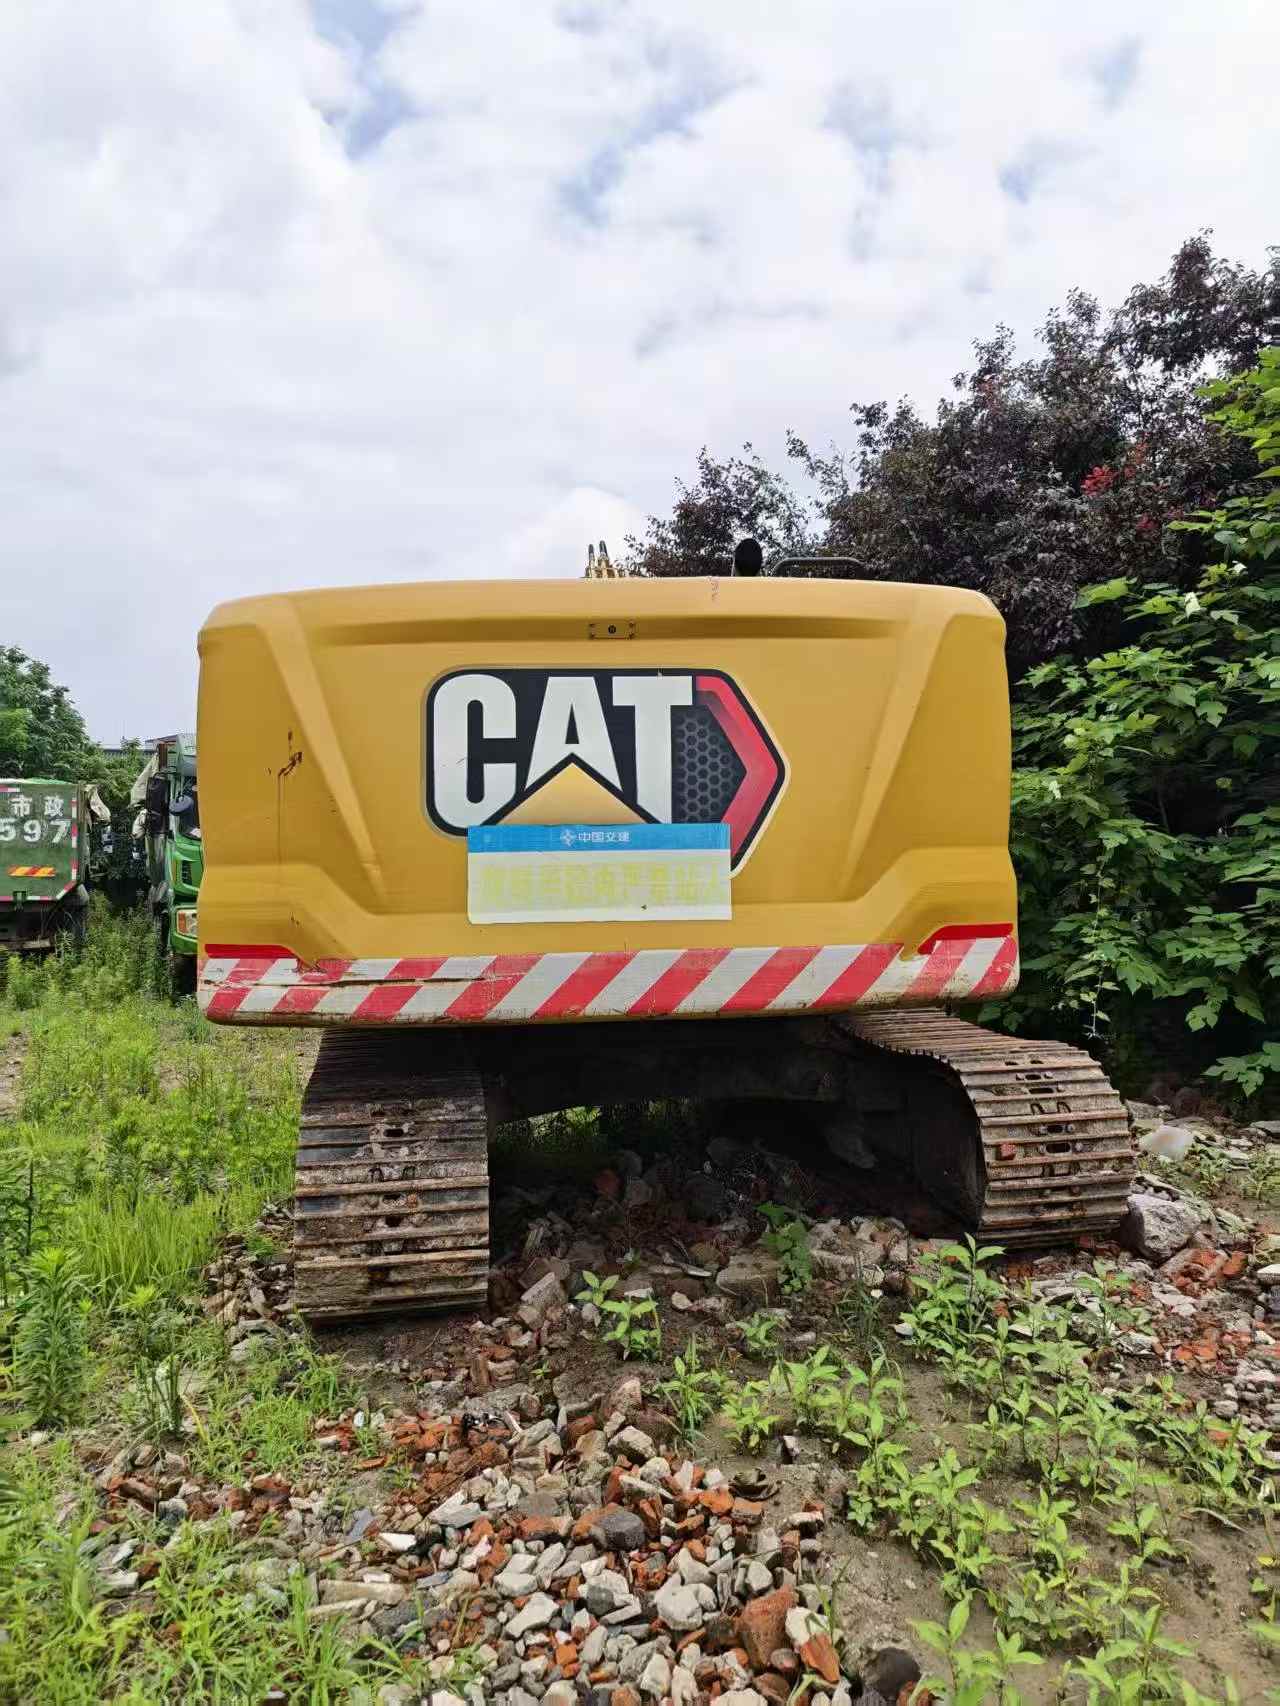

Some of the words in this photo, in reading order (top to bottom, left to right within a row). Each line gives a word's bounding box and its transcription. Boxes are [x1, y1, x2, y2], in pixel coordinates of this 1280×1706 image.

[433, 673, 693, 827] CAT
[10, 795, 65, 817] 市政
[578, 831, 630, 843] 中国交建
